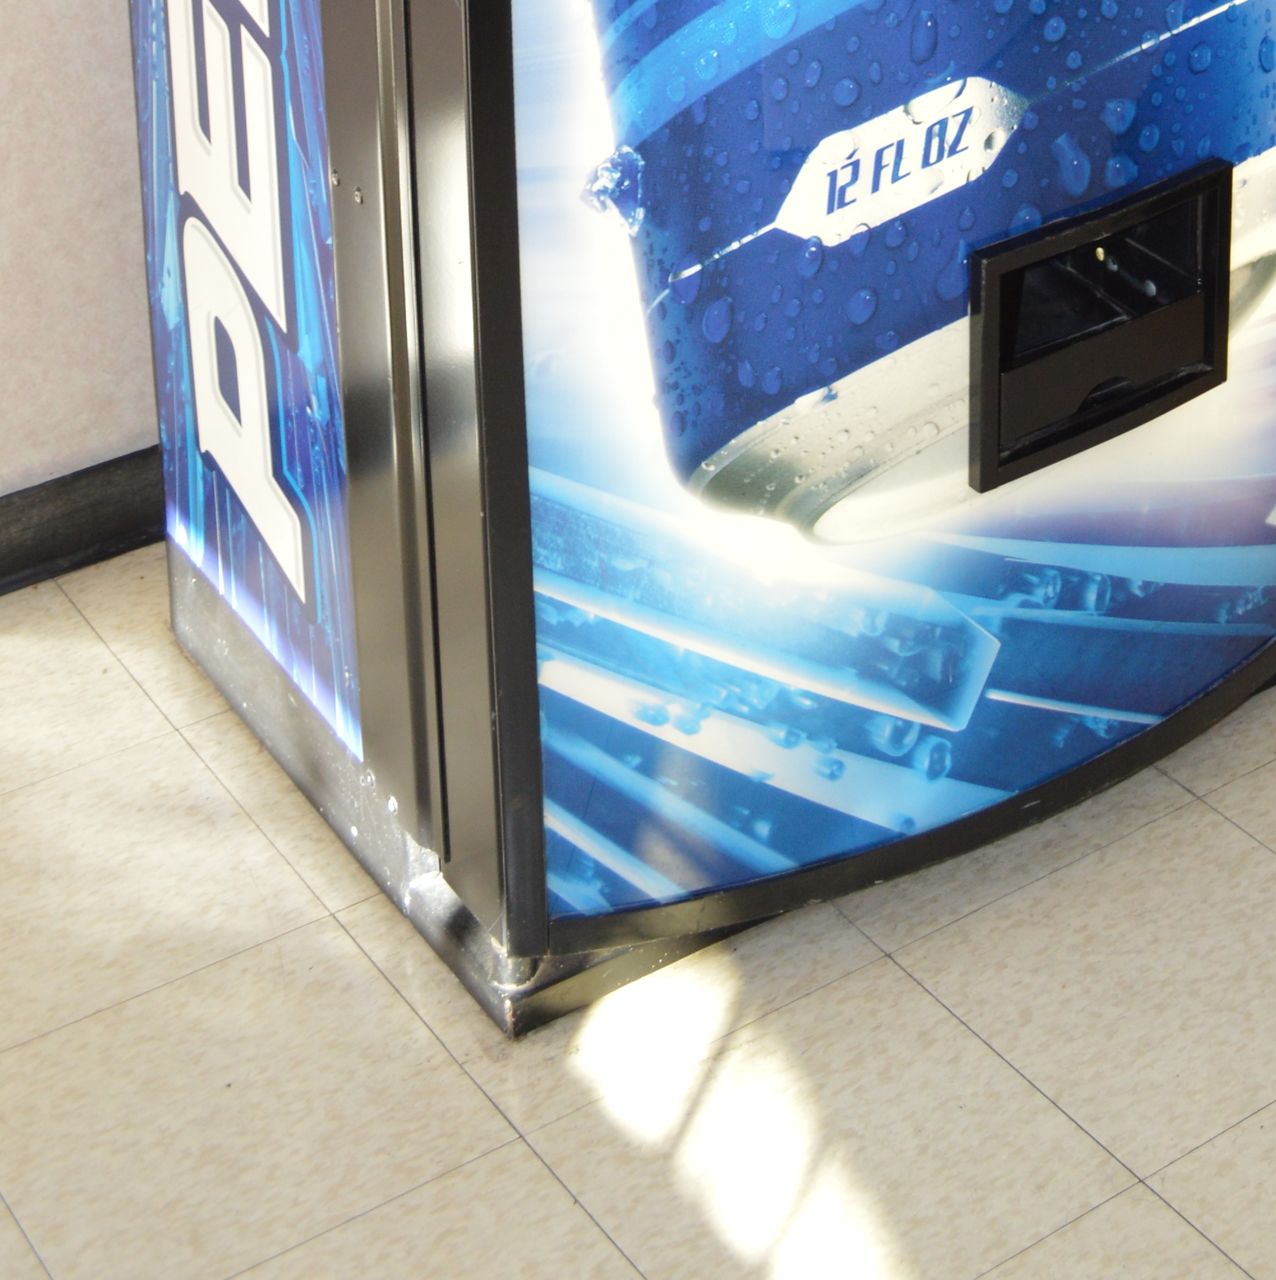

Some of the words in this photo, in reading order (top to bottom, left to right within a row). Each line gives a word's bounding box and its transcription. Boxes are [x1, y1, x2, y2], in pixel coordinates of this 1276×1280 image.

[825, 157, 861, 216] 12
[870, 137, 912, 195] FL
[921, 105, 975, 170] OZ
